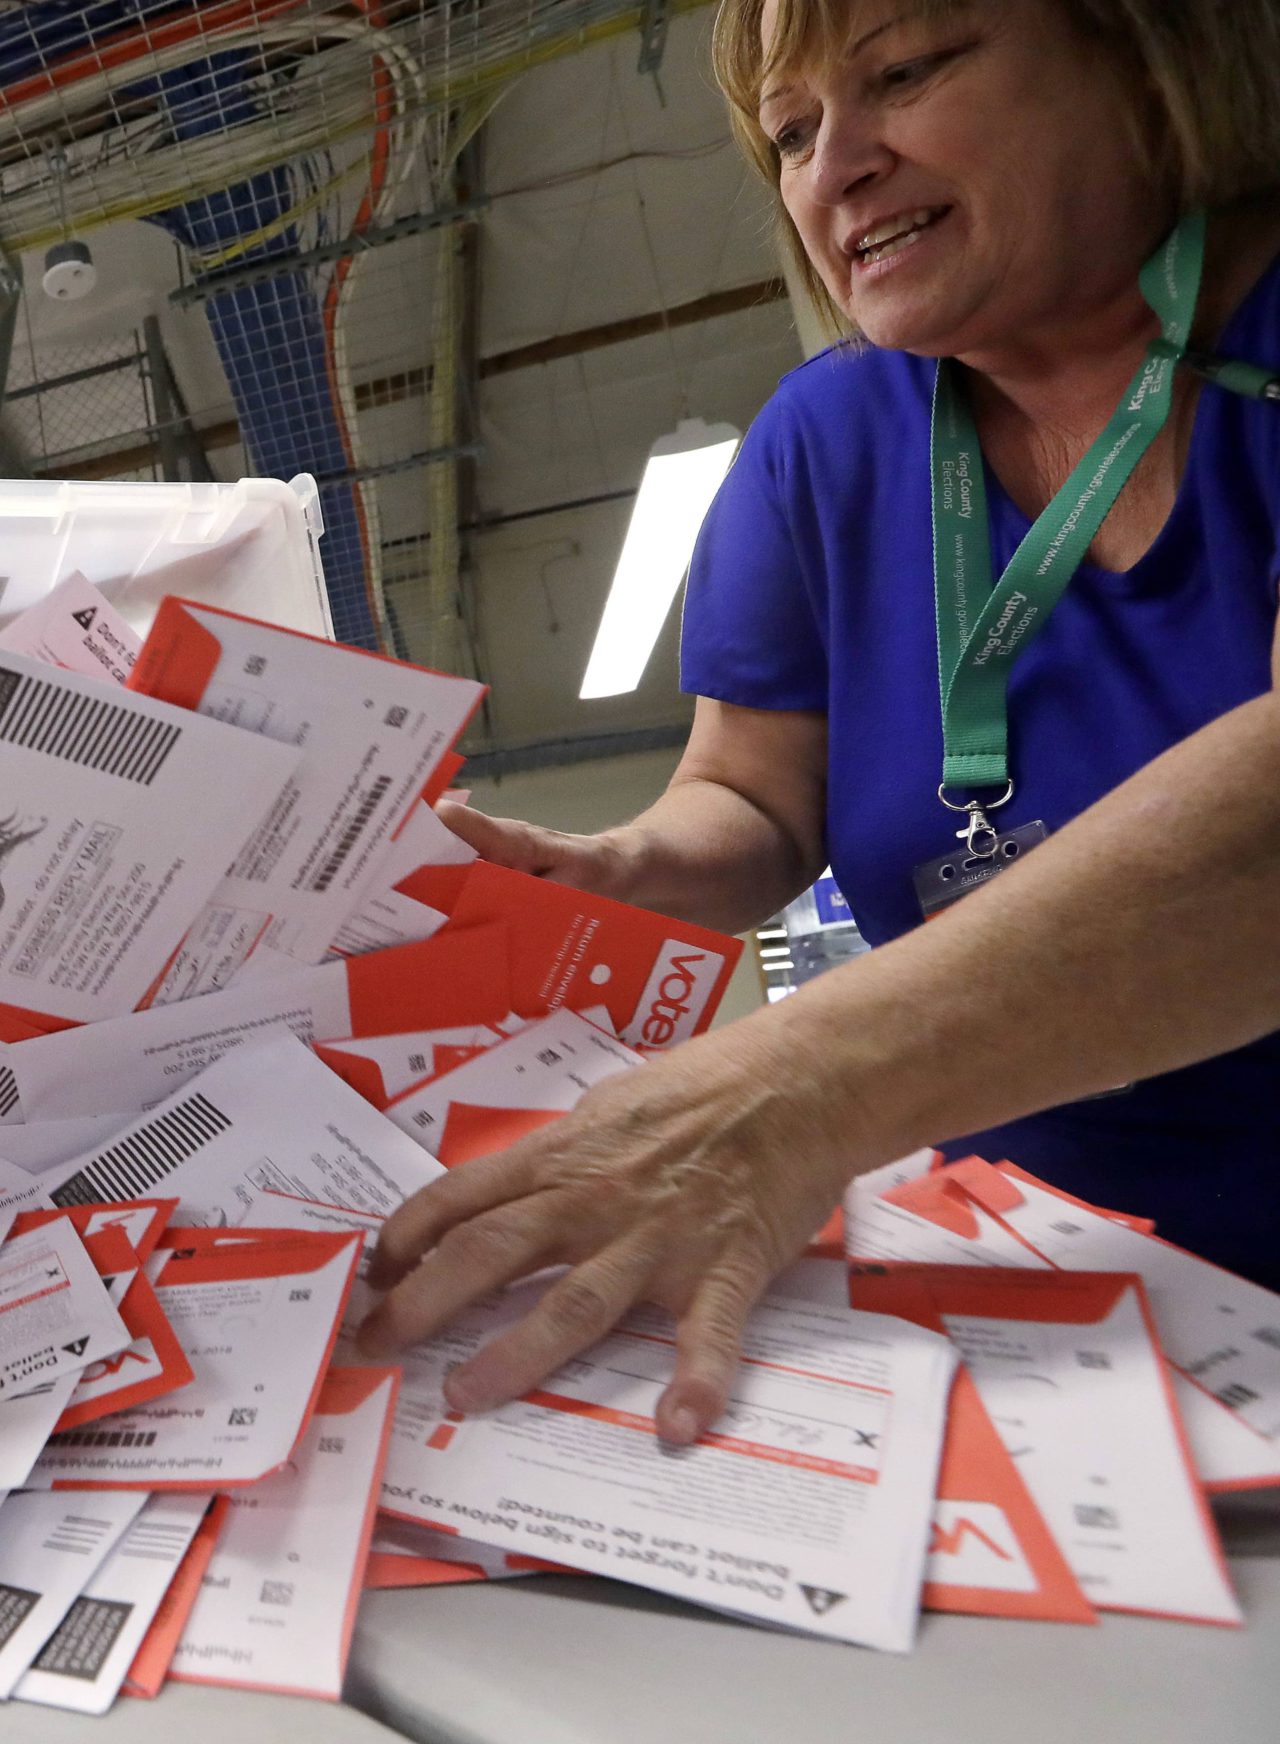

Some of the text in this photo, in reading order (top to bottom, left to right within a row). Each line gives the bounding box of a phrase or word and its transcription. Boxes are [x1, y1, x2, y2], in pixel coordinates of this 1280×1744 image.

[1128, 373, 1153, 411] King
[942, 460, 954, 510] Elections
[958, 451, 973, 519] King County
[972, 590, 1028, 666] King County
[997, 606, 1038, 656] Elections
[45, 854, 63, 874] not
[15, 909, 61, 973] BUSINESS
[53, 862, 87, 906] REPLY
[81, 829, 109, 861] MAIL
[4, 1347, 54, 1371] ballot
[9, 1356, 59, 1382] Don't
[418, 1492, 445, 1511] so
[447, 1501, 519, 1532] below
[498, 1496, 791, 1581] ballot can be counted!
[524, 1520, 576, 1547] sign
[582, 1536, 609, 1556] to
[614, 1544, 700, 1579] forget
[705, 1568, 785, 1602] Don't
